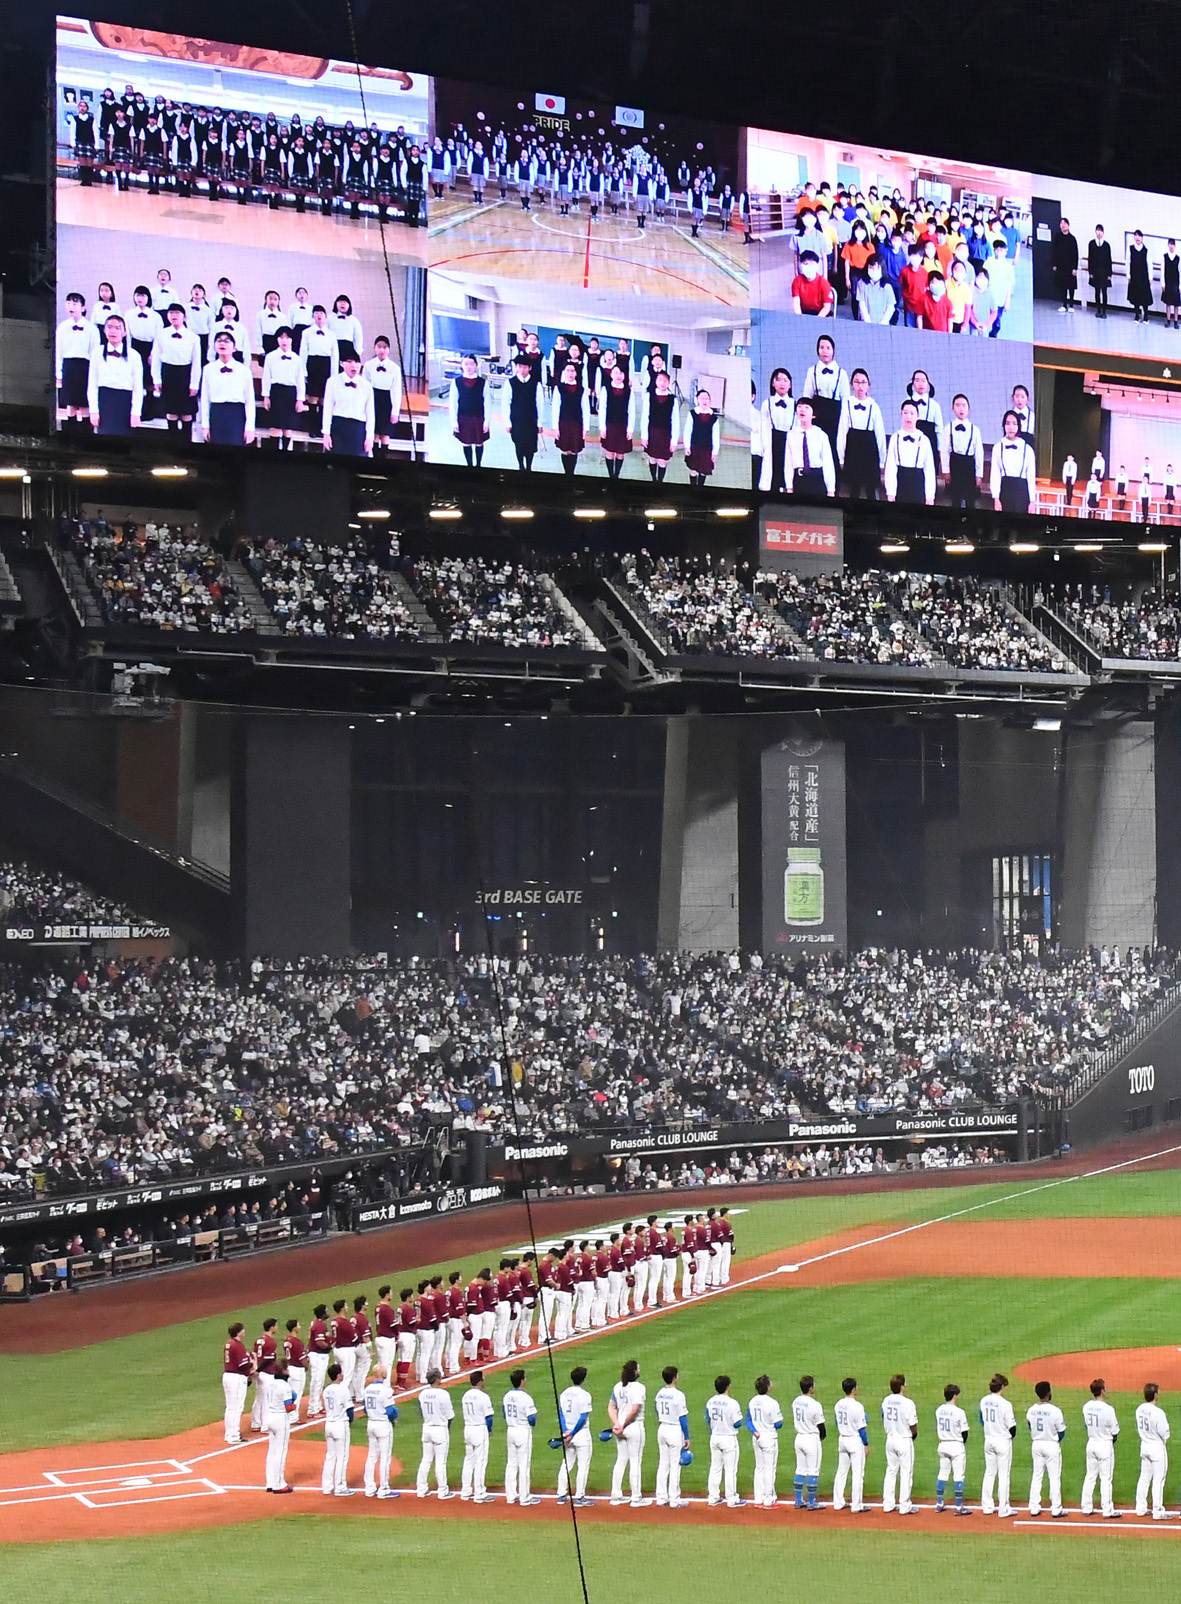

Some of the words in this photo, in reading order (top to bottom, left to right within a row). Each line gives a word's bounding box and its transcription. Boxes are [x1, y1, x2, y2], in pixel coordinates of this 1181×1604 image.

[766, 529, 836, 546] 富士メガネ
[475, 890, 501, 904] 3rd
[503, 890, 541, 904] BASE
[545, 890, 582, 904] GATE
[1129, 1065, 1154, 1094] TOTO
[789, 1121, 857, 1136] Panasonic
[896, 1117, 946, 1130] Panasonic
[948, 1116, 975, 1127] CLUB
[976, 1114, 1018, 1126] LOUNGE
[611, 1136, 655, 1150] Panasonic
[657, 1133, 681, 1146] CLUB
[682, 1130, 718, 1143] LOUNGE
[505, 1142, 568, 1160] Panasonic
[661, 1402, 670, 1415] 15
[712, 1408, 723, 1422] 24
[886, 1407, 898, 1421] 23
[985, 1408, 996, 1422] 10
[939, 1418, 950, 1432] 50
[1037, 1418, 1044, 1432] 6
[1087, 1413, 1099, 1427] 37
